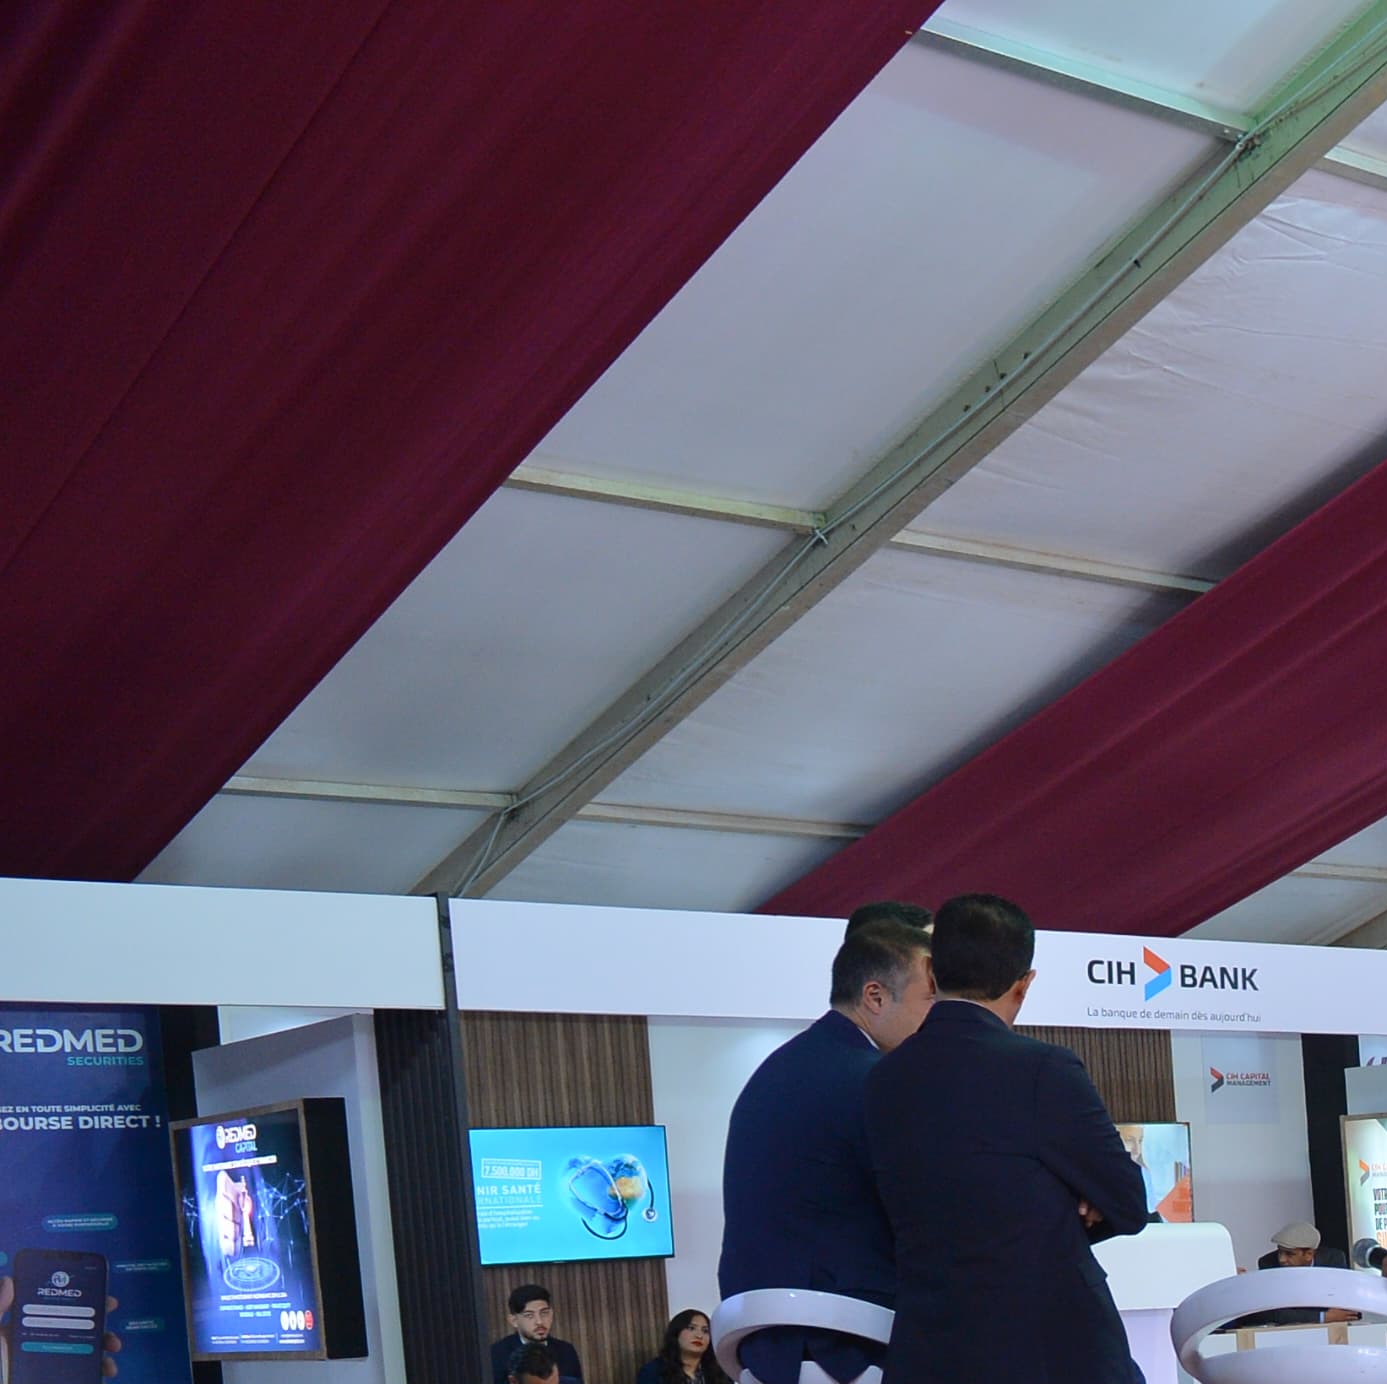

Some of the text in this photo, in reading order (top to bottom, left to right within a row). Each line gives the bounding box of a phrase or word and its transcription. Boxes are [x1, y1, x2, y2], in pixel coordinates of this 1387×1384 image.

[1087, 959, 1259, 992] CIH BANK
[1087, 1007, 1261, 1023] La banque de demain dès aujourd'hui
[67, 1056, 144, 1066] SECURITIES
[32, 1104, 62, 1112] TOUTE
[64, 1103, 114, 1112] SIMPLICITÉ
[78, 1116, 150, 1130] DIRECT
[502, 1182, 542, 1195] SANTÉ
[1376, 1218, 1382, 1230] DE
[38, 1288, 82, 1298] REDMED
